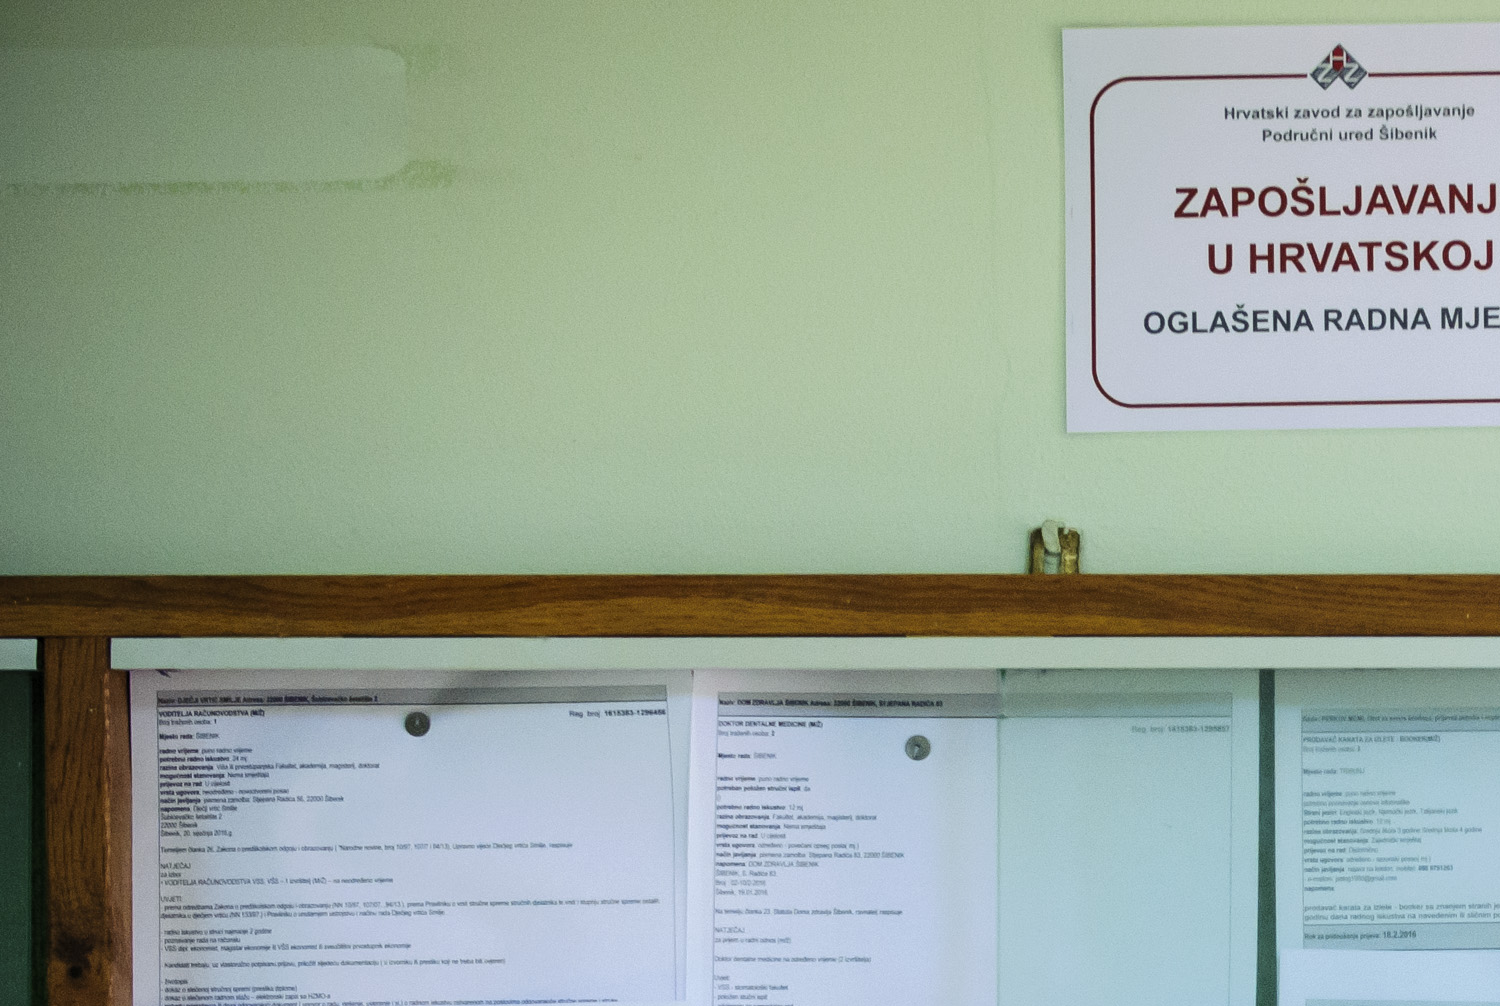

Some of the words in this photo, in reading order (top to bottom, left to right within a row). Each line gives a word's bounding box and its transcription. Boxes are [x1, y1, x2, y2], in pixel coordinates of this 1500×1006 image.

[1224, 106, 1289, 122] Hrvatski
[1293, 105, 1340, 119] zavod
[1345, 107, 1362, 119] za
[1367, 103, 1475, 121] zapošljavanje
[1262, 127, 1333, 144] Područni
[1338, 127, 1373, 142] ured
[1378, 124, 1438, 141] Šibenik
[1207, 243, 1232, 274] U
[1250, 240, 1494, 274] HRVATSKOJ
[1143, 303, 1314, 334] OGLAŠENA
[1323, 308, 1430, 333] RADNA
